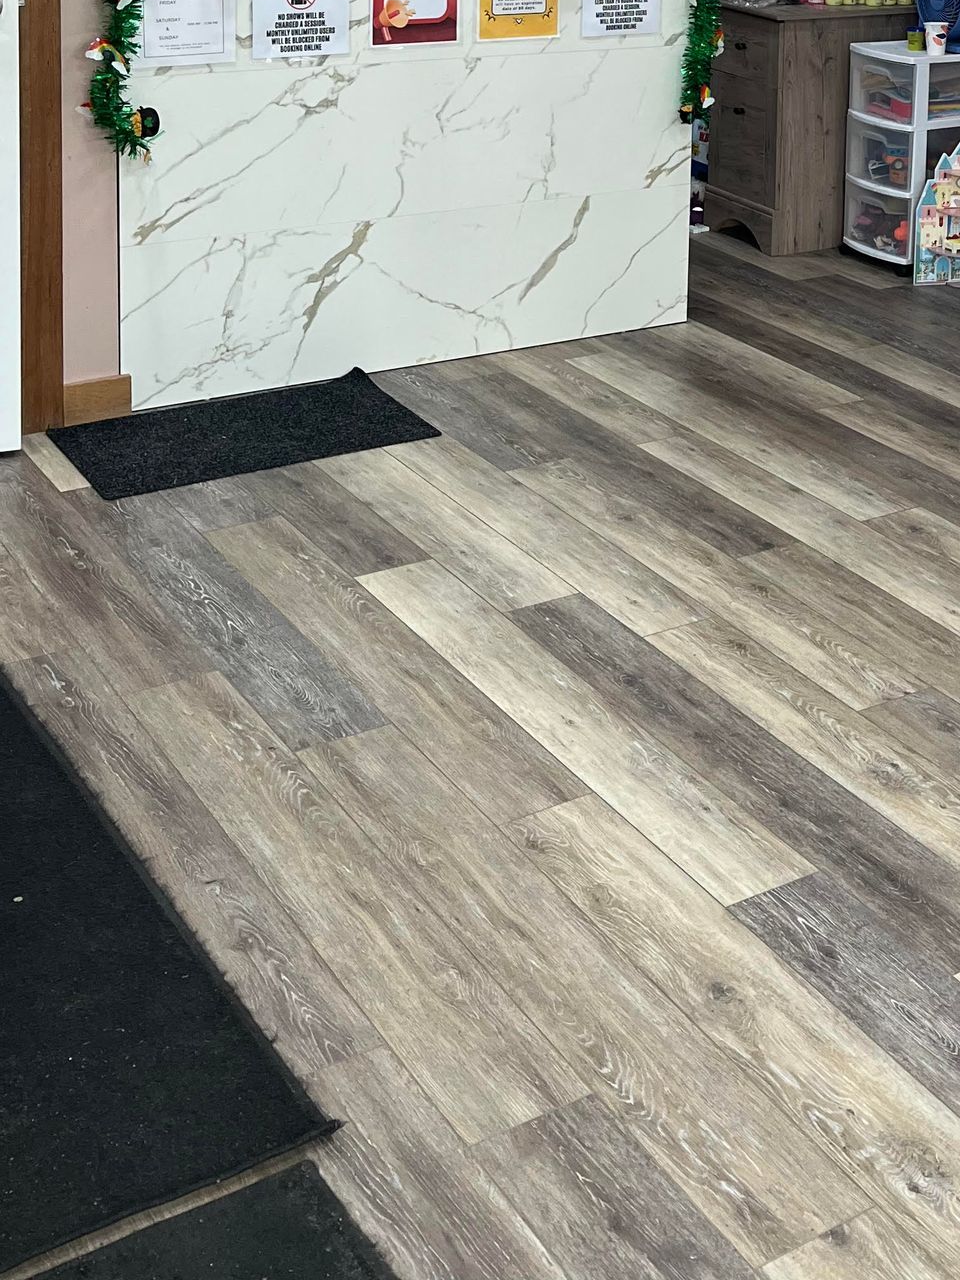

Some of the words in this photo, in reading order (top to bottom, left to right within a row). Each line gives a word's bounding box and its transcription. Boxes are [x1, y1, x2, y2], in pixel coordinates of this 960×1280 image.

[275, 21, 299, 29] CHARGED
[266, 29, 290, 37] MONTHLY
[291, 28, 318, 36] UNLIMITED
[292, 36, 315, 44] BLOCKED
[280, 45, 303, 53] BOOKING
[304, 43, 322, 51] ONLINE
